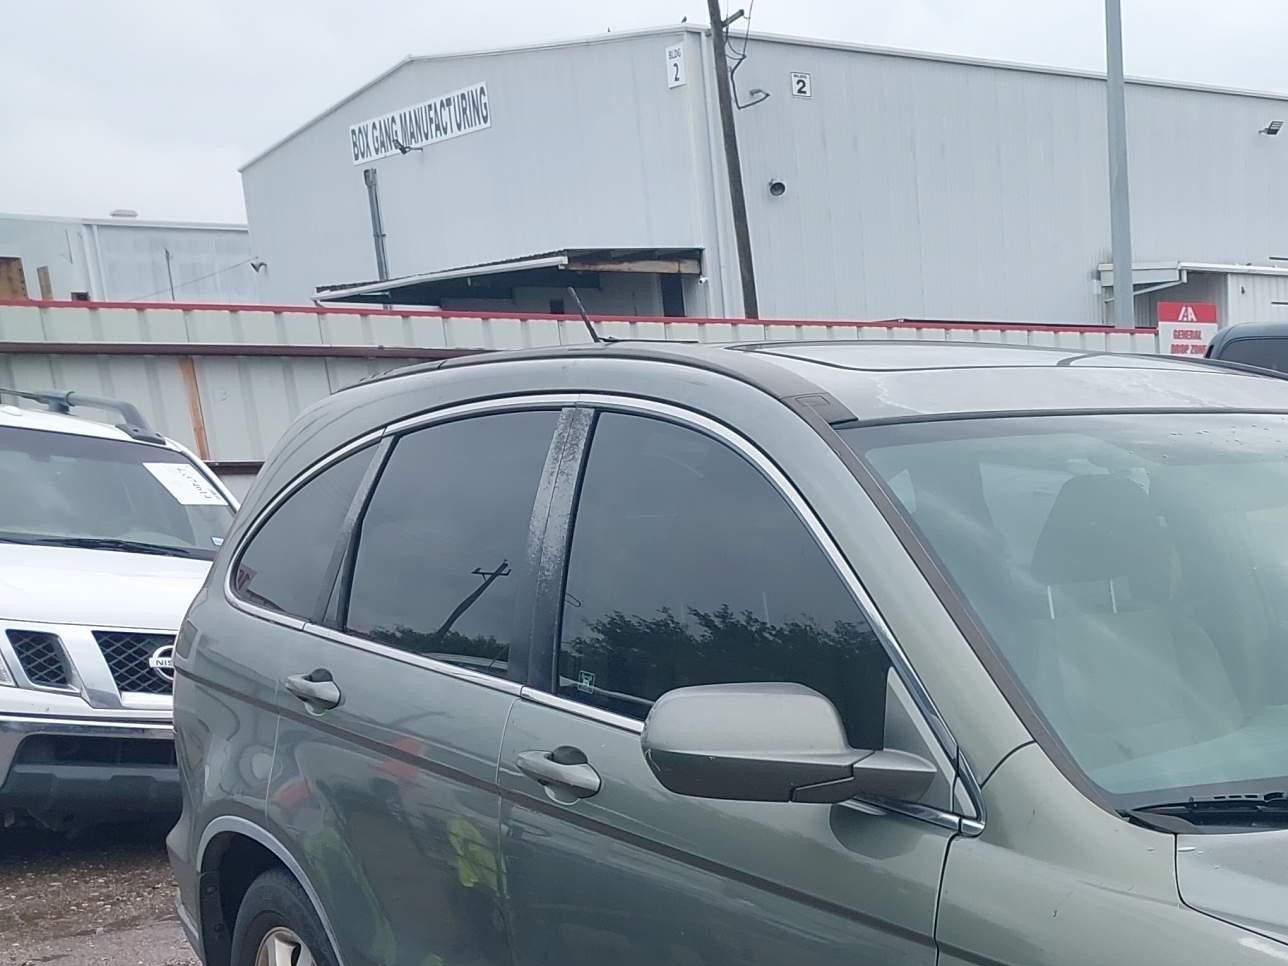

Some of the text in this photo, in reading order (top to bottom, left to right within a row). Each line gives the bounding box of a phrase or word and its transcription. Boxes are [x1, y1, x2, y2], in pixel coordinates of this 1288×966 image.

[673, 63, 680, 82] 2
[796, 79, 807, 94] 2
[351, 86, 489, 161] BOX GANG MANUFACTURING
